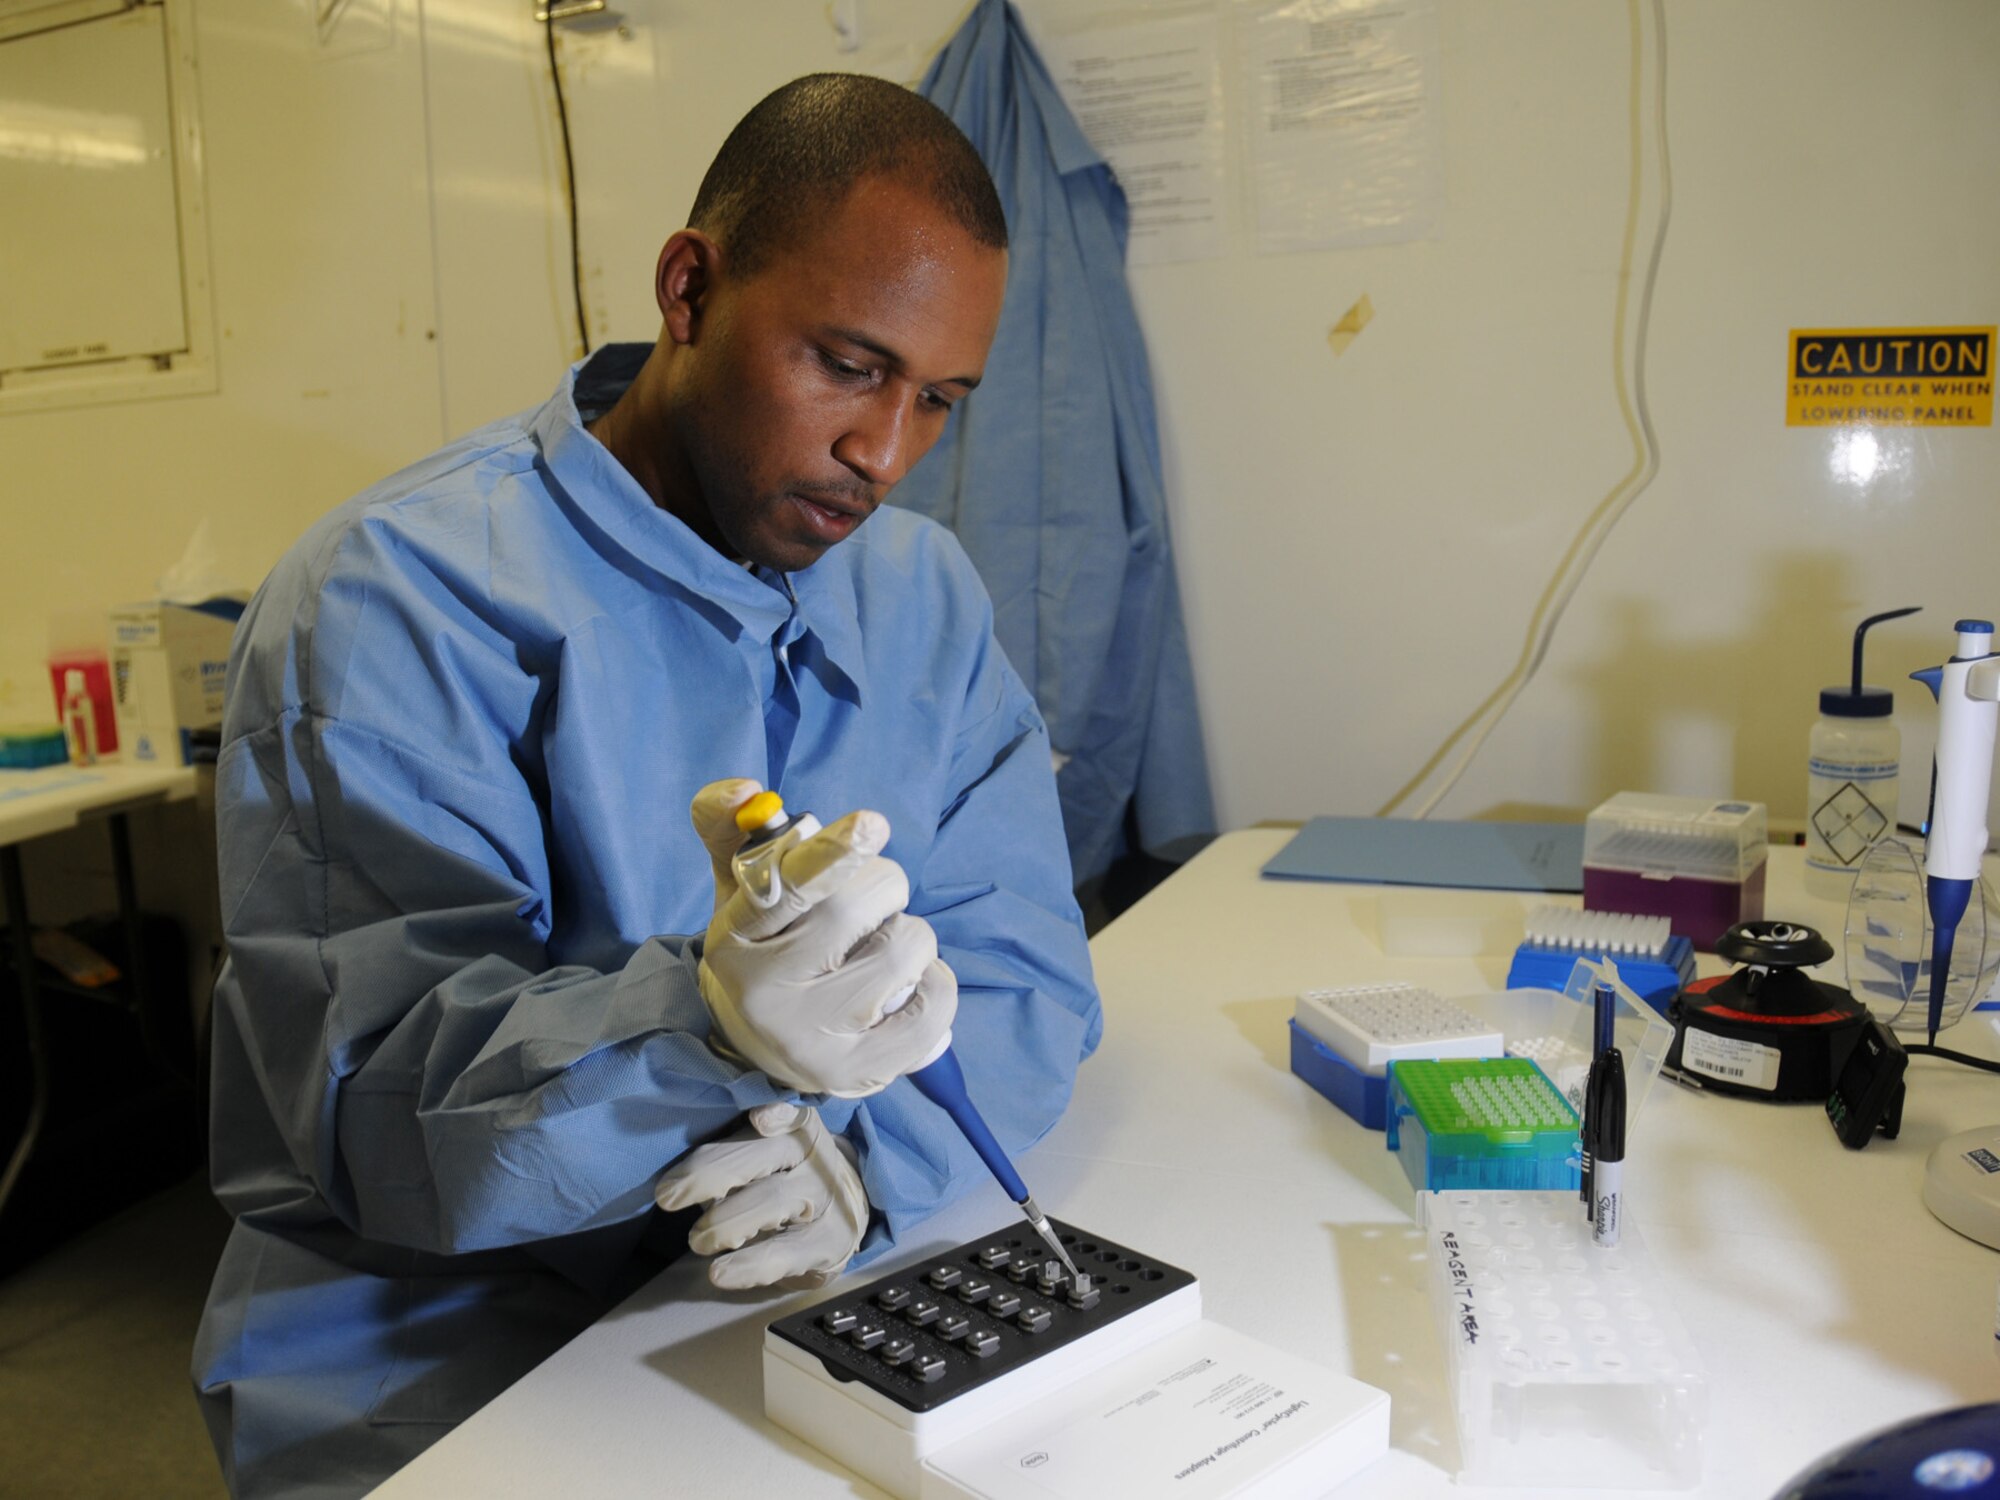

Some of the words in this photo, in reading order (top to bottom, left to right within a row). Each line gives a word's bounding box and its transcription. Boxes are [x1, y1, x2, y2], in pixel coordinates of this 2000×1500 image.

[1800, 340, 1984, 374] CAUTION
[1793, 382, 1855, 397] STAND
[1862, 382, 1921, 396] CLEAR
[1931, 382, 1991, 396] WHEN
[1801, 406, 1904, 421] LOWERING
[1912, 405, 1976, 420] PANEL
[1596, 1193, 1611, 1236] Sharpie
[1440, 1231, 1474, 1299] REAGENT
[1460, 1303, 1480, 1344] AREA
[1214, 1428, 1261, 1458] Centrifuge
[1174, 1454, 1217, 1481] Adapters
